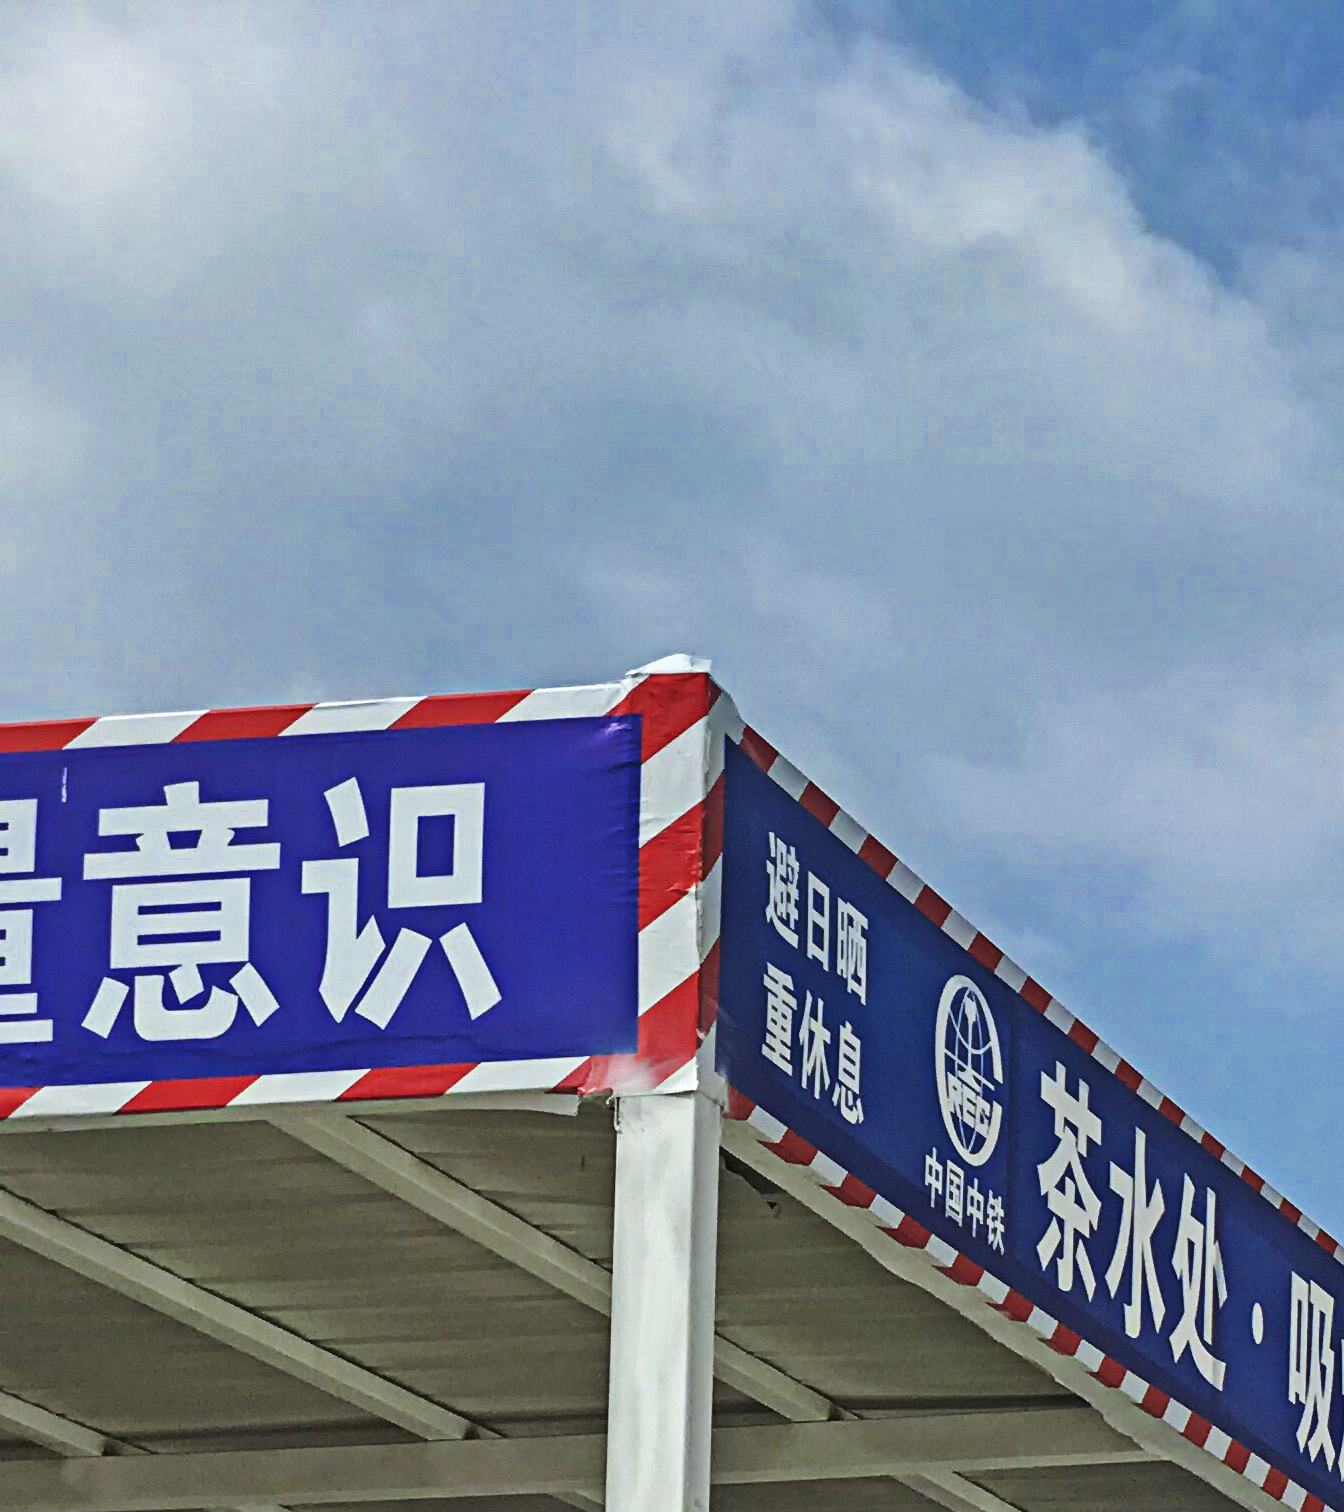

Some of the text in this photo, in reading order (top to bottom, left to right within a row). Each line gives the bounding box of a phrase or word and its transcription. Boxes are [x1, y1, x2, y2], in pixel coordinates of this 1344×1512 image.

[766, 832, 868, 1006] 避日晒
[761, 962, 864, 1125] 重休息
[924, 1146, 1005, 1256] 中国中铁
